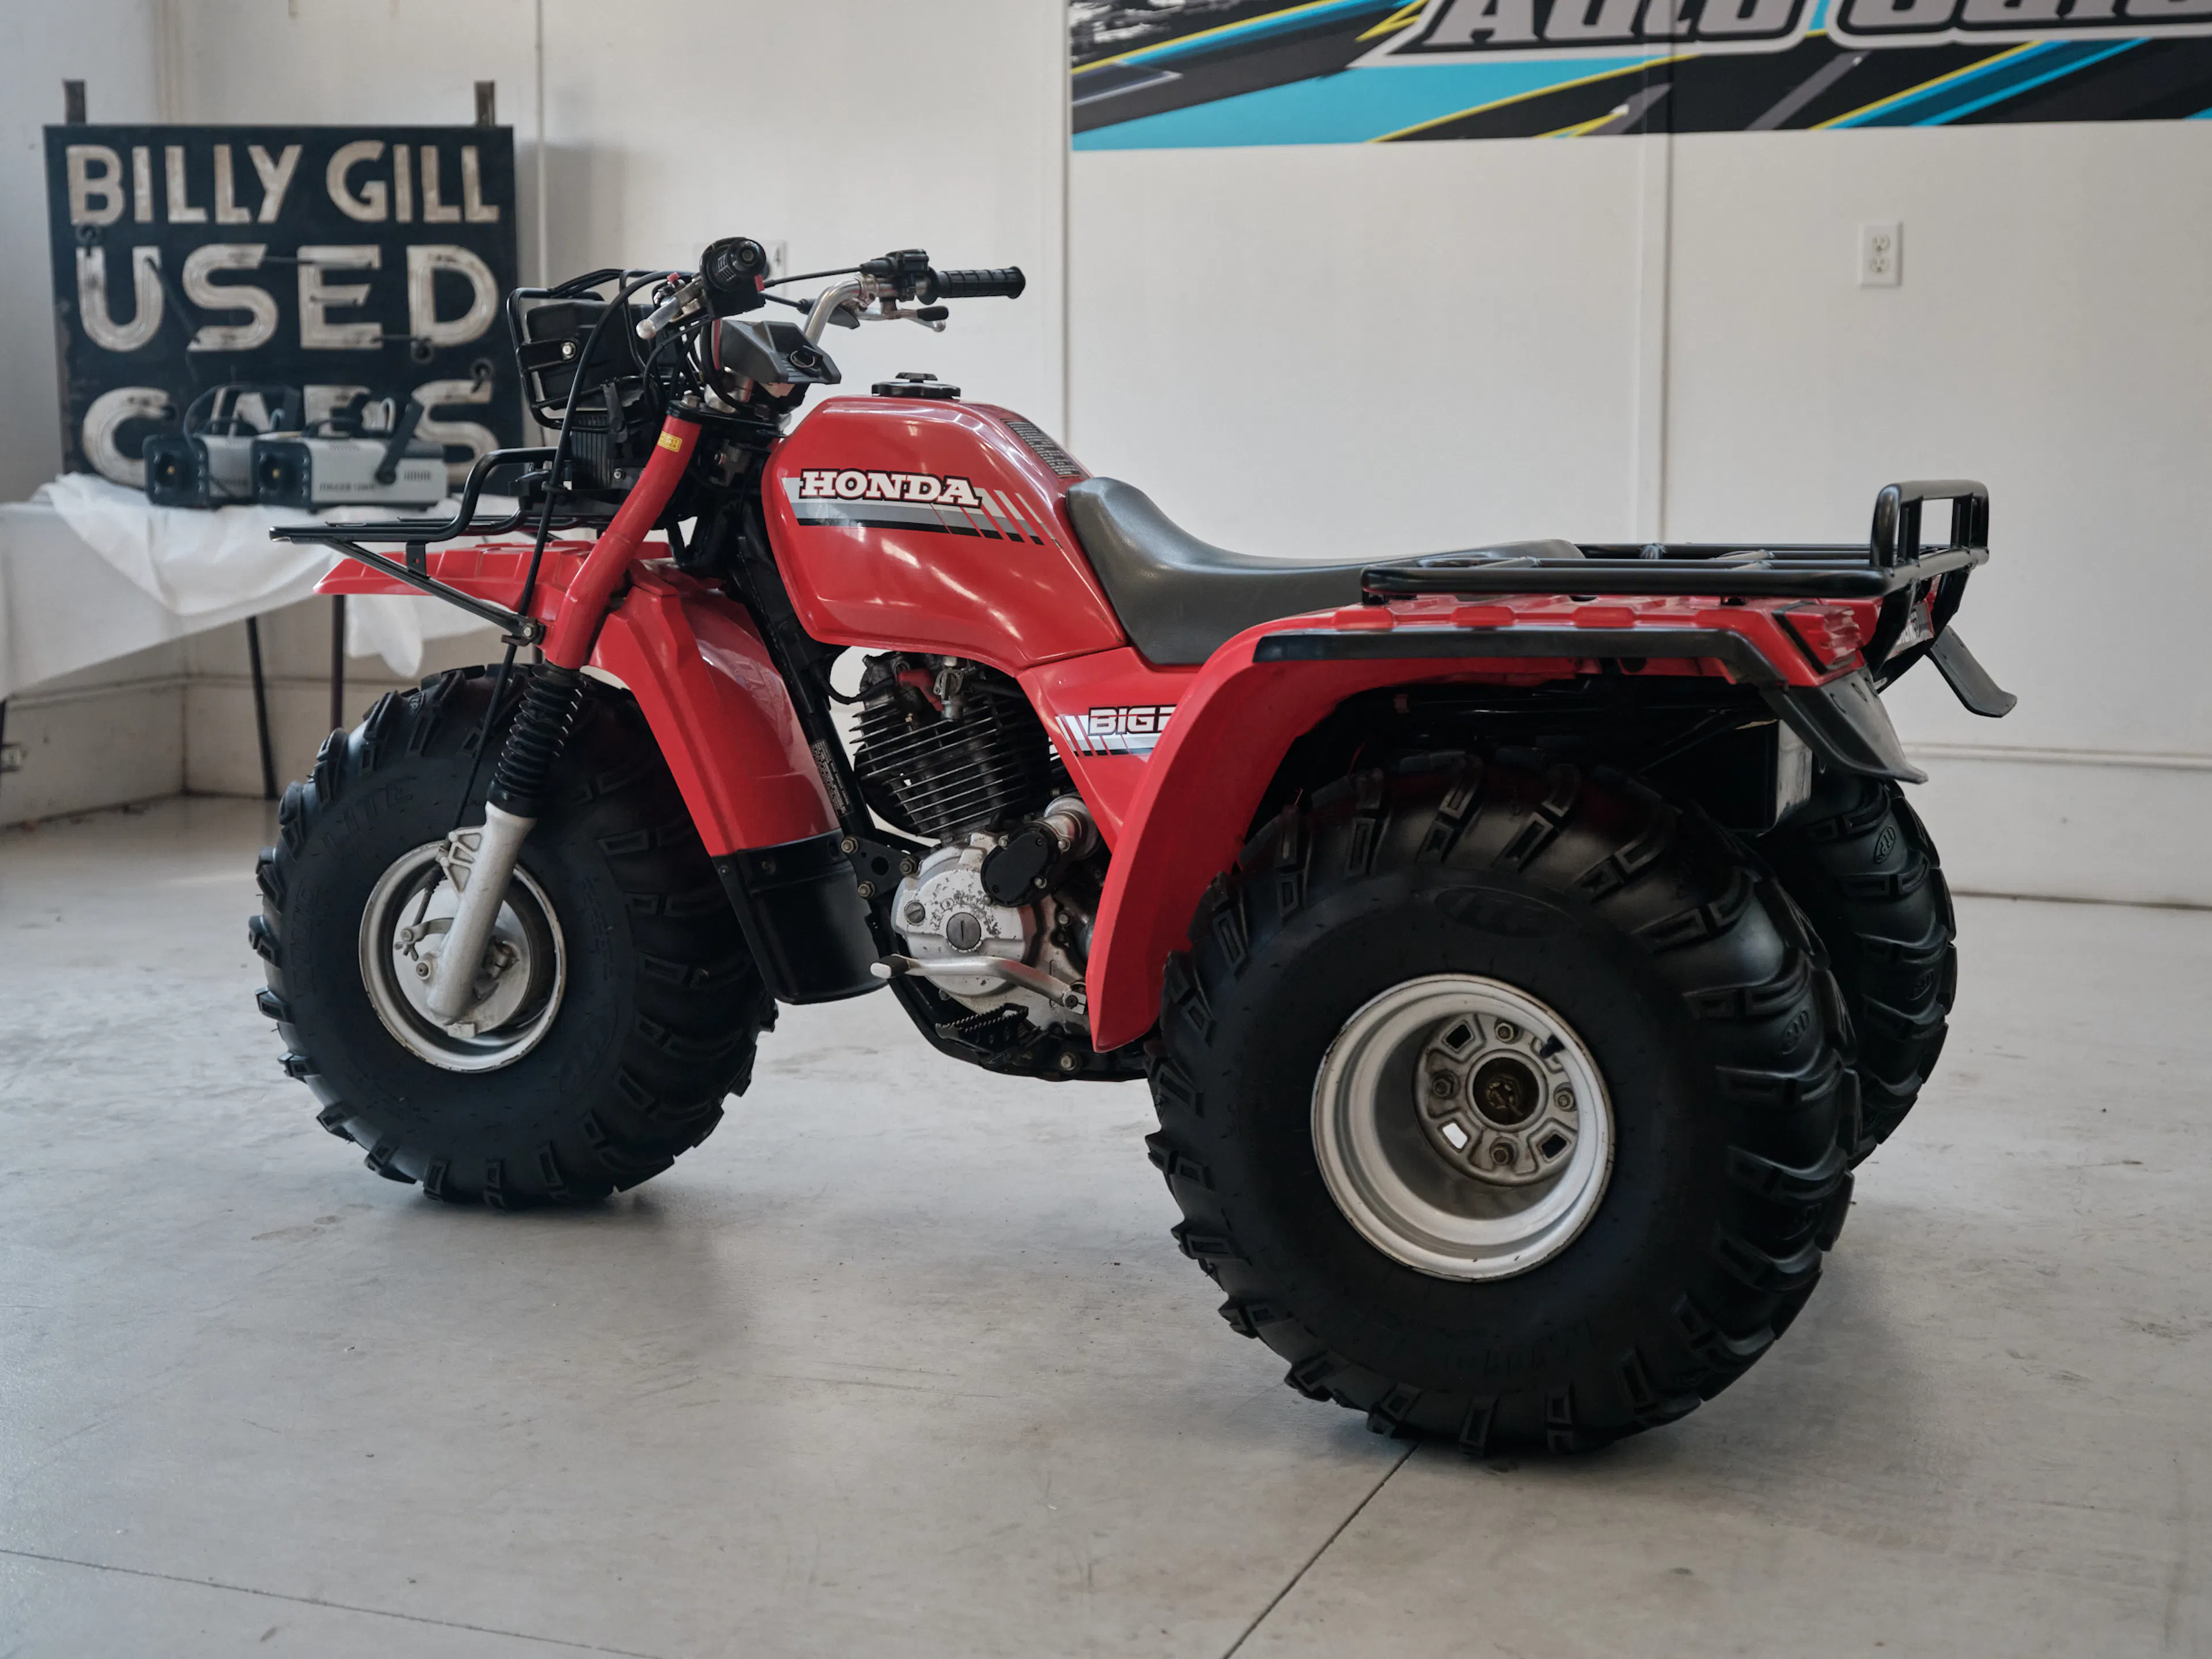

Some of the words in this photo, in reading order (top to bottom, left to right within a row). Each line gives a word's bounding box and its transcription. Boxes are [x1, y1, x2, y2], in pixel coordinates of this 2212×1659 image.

[66, 144, 303, 226] BILLY
[326, 140, 500, 224] GILL
[75, 243, 499, 352] USED
[799, 468, 983, 508] HONDA
